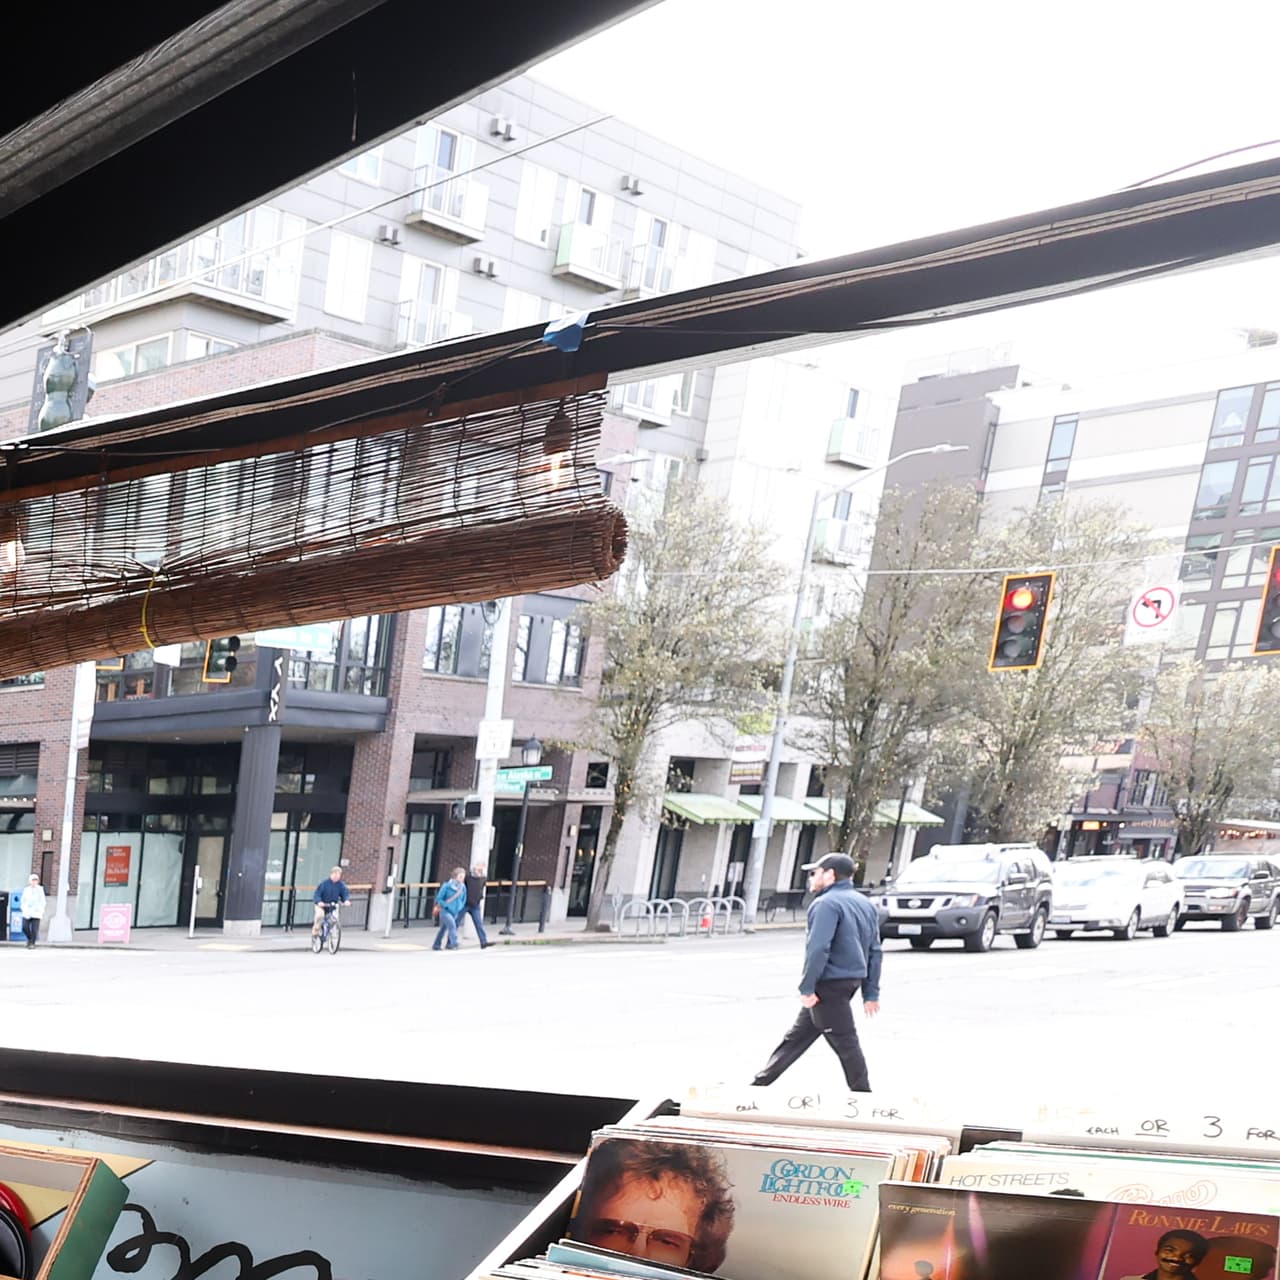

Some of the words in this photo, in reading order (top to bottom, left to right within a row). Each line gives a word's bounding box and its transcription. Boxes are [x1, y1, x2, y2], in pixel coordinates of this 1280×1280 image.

[845, 1097, 860, 1119] 3
[871, 1107, 905, 1121] FOR
[1139, 1118, 1171, 1133] OR
[1202, 1115, 1224, 1139] 3
[950, 1174, 985, 1187] HOT
[988, 1171, 1071, 1187] STREETS
[772, 1193, 822, 1207] ENDLESS
[823, 1197, 852, 1209] WIRE
[1128, 1208, 1209, 1233] RONNIE
[1209, 1212, 1272, 1239] LAWS
